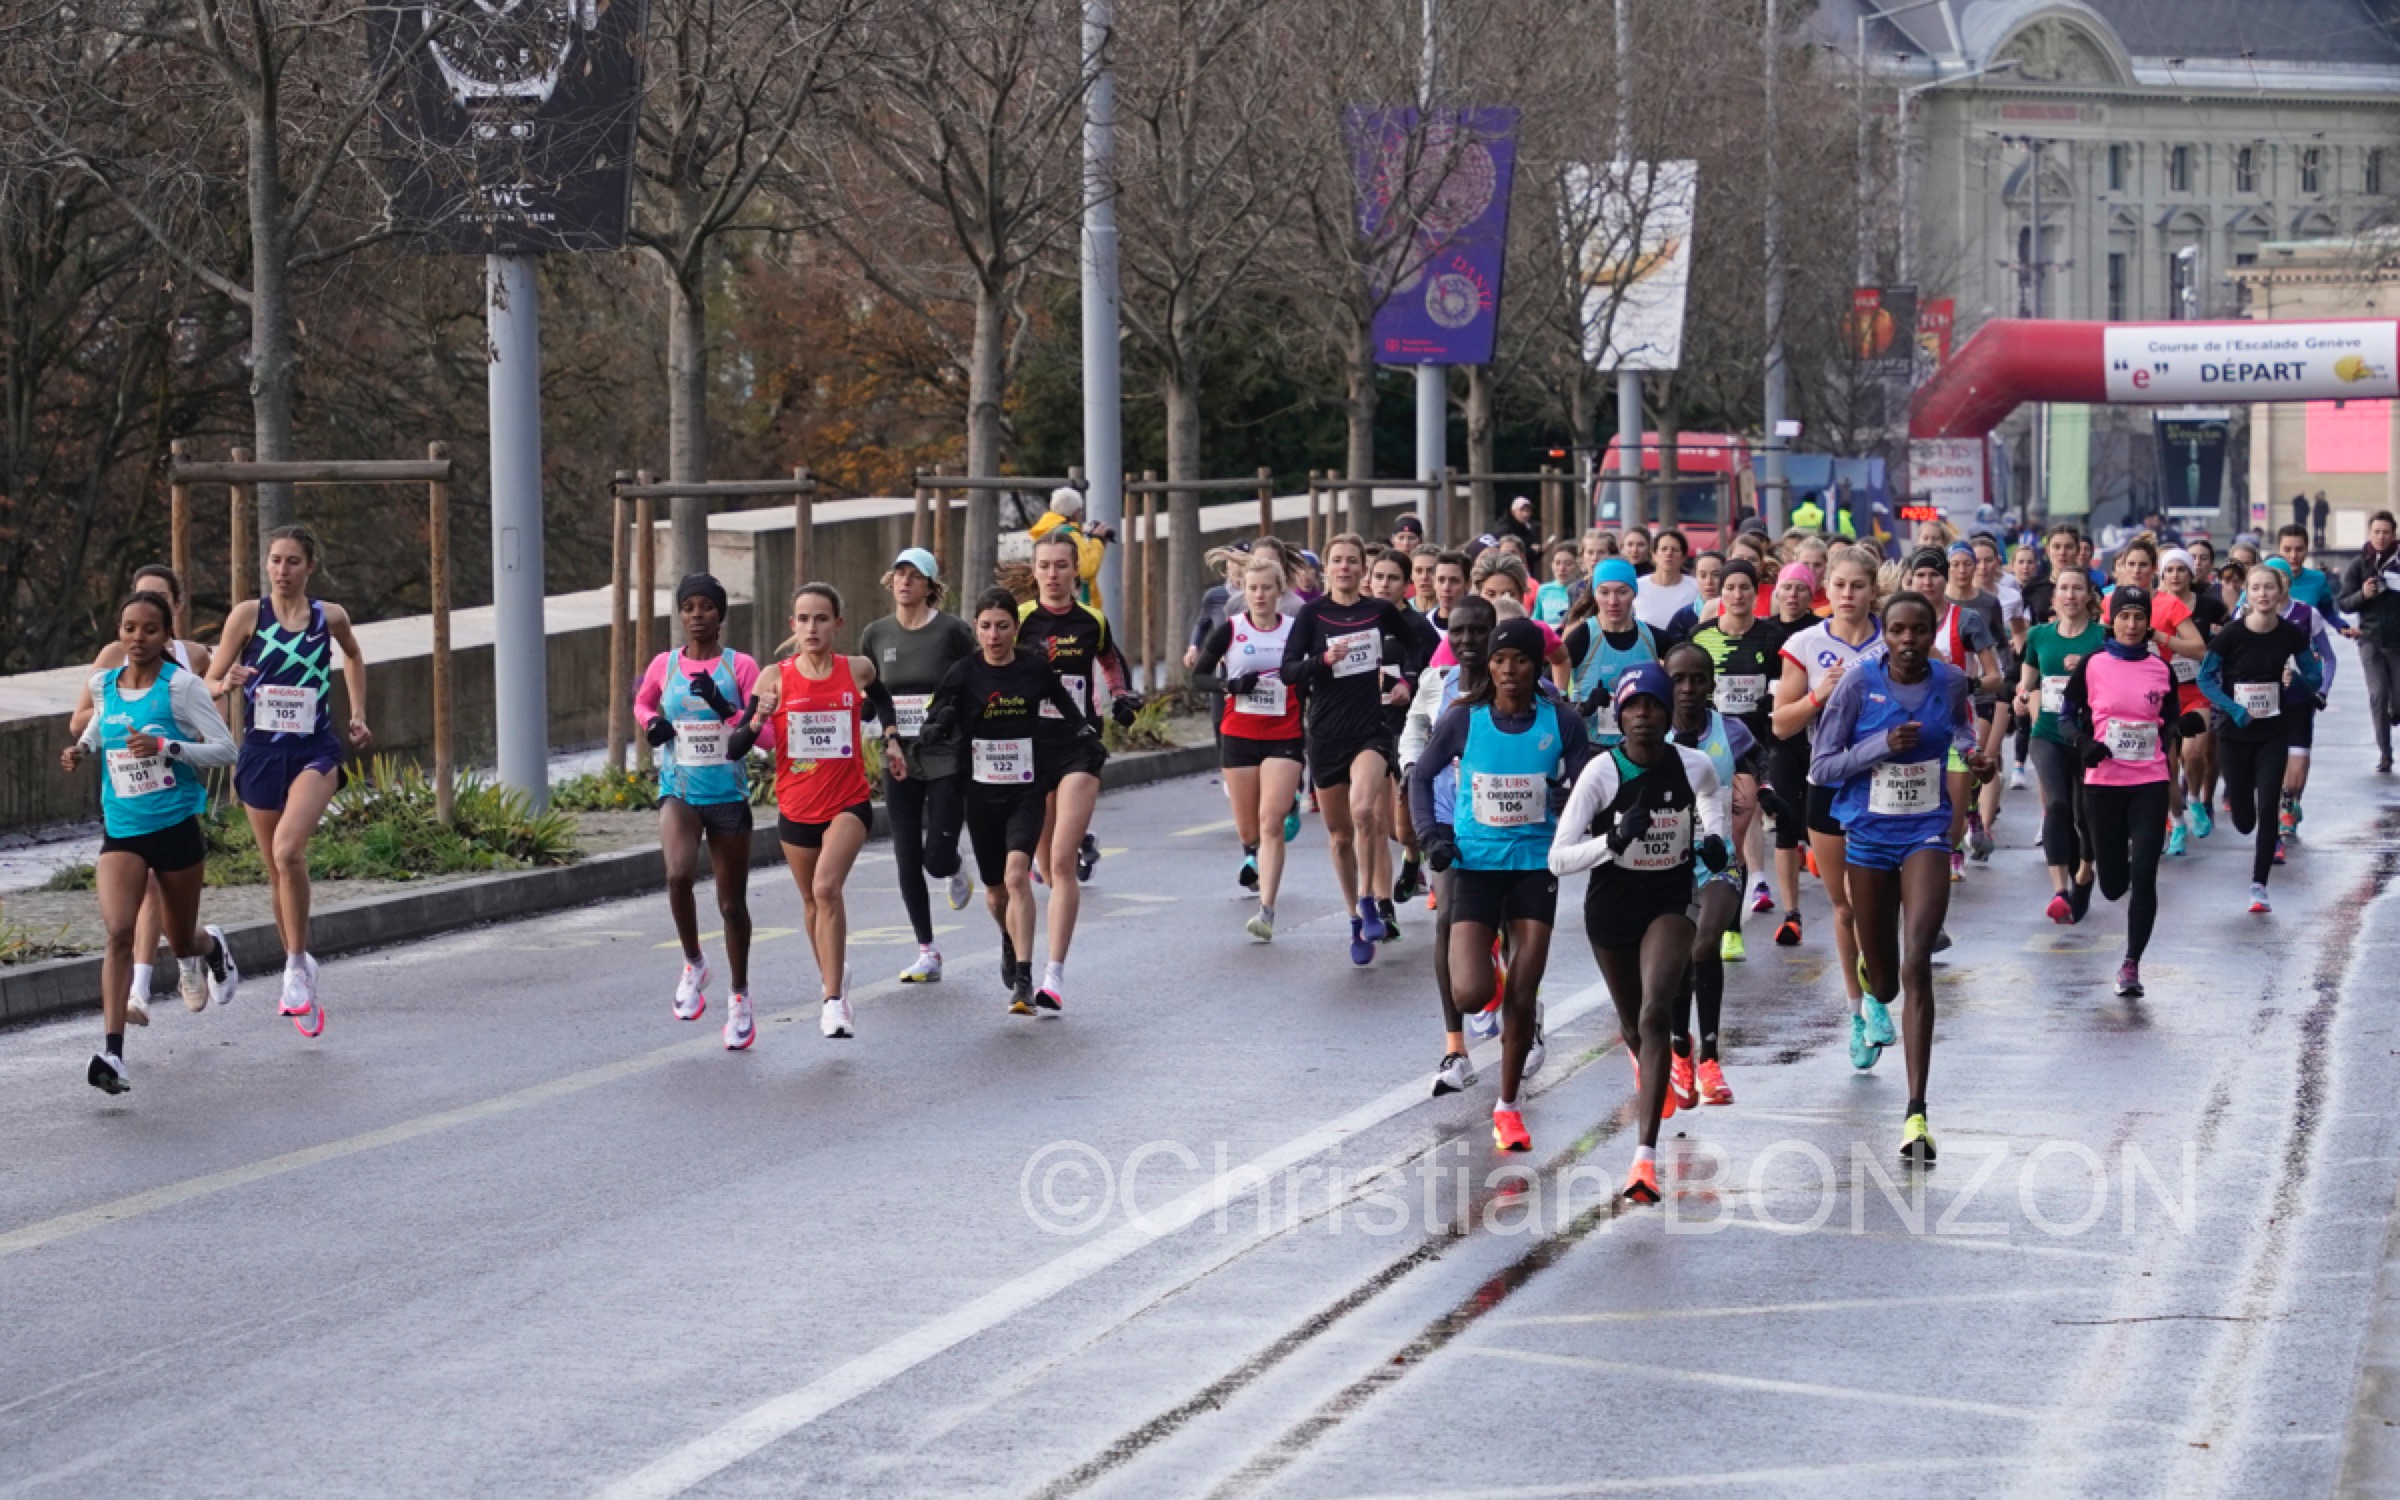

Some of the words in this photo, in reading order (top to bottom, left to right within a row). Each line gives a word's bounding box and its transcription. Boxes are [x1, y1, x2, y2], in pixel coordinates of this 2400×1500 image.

[2148, 341, 2199, 353] Course
[2203, 341, 2222, 352] de
[2226, 338, 2299, 352] l'Escalade
[2305, 336, 2362, 349] Genève
[2200, 357, 2307, 383] DÉPART
[267, 688, 305, 697] MIGROS
[275, 709, 297, 719] 105
[814, 714, 837, 724] UBS
[683, 723, 721, 732] MIGROS
[809, 735, 831, 745] 104
[694, 743, 715, 753] 103
[997, 743, 1019, 751] UBS
[993, 761, 1013, 771] 122
[1903, 765, 1927, 777] UBS
[129, 769, 150, 783] 101
[987, 773, 1019, 781] MIGROS
[137, 780, 159, 792] UBS
[1505, 777, 1531, 788] UBS
[1487, 790, 1533, 799] CHEROTICH
[1896, 789, 1919, 801] 112
[1497, 801, 1523, 813] 106
[1489, 814, 1529, 824] MIGROS
[1649, 815, 1679, 829] UBS
[1643, 842, 1671, 856] 102
[1633, 855, 1678, 868] MIGROS
